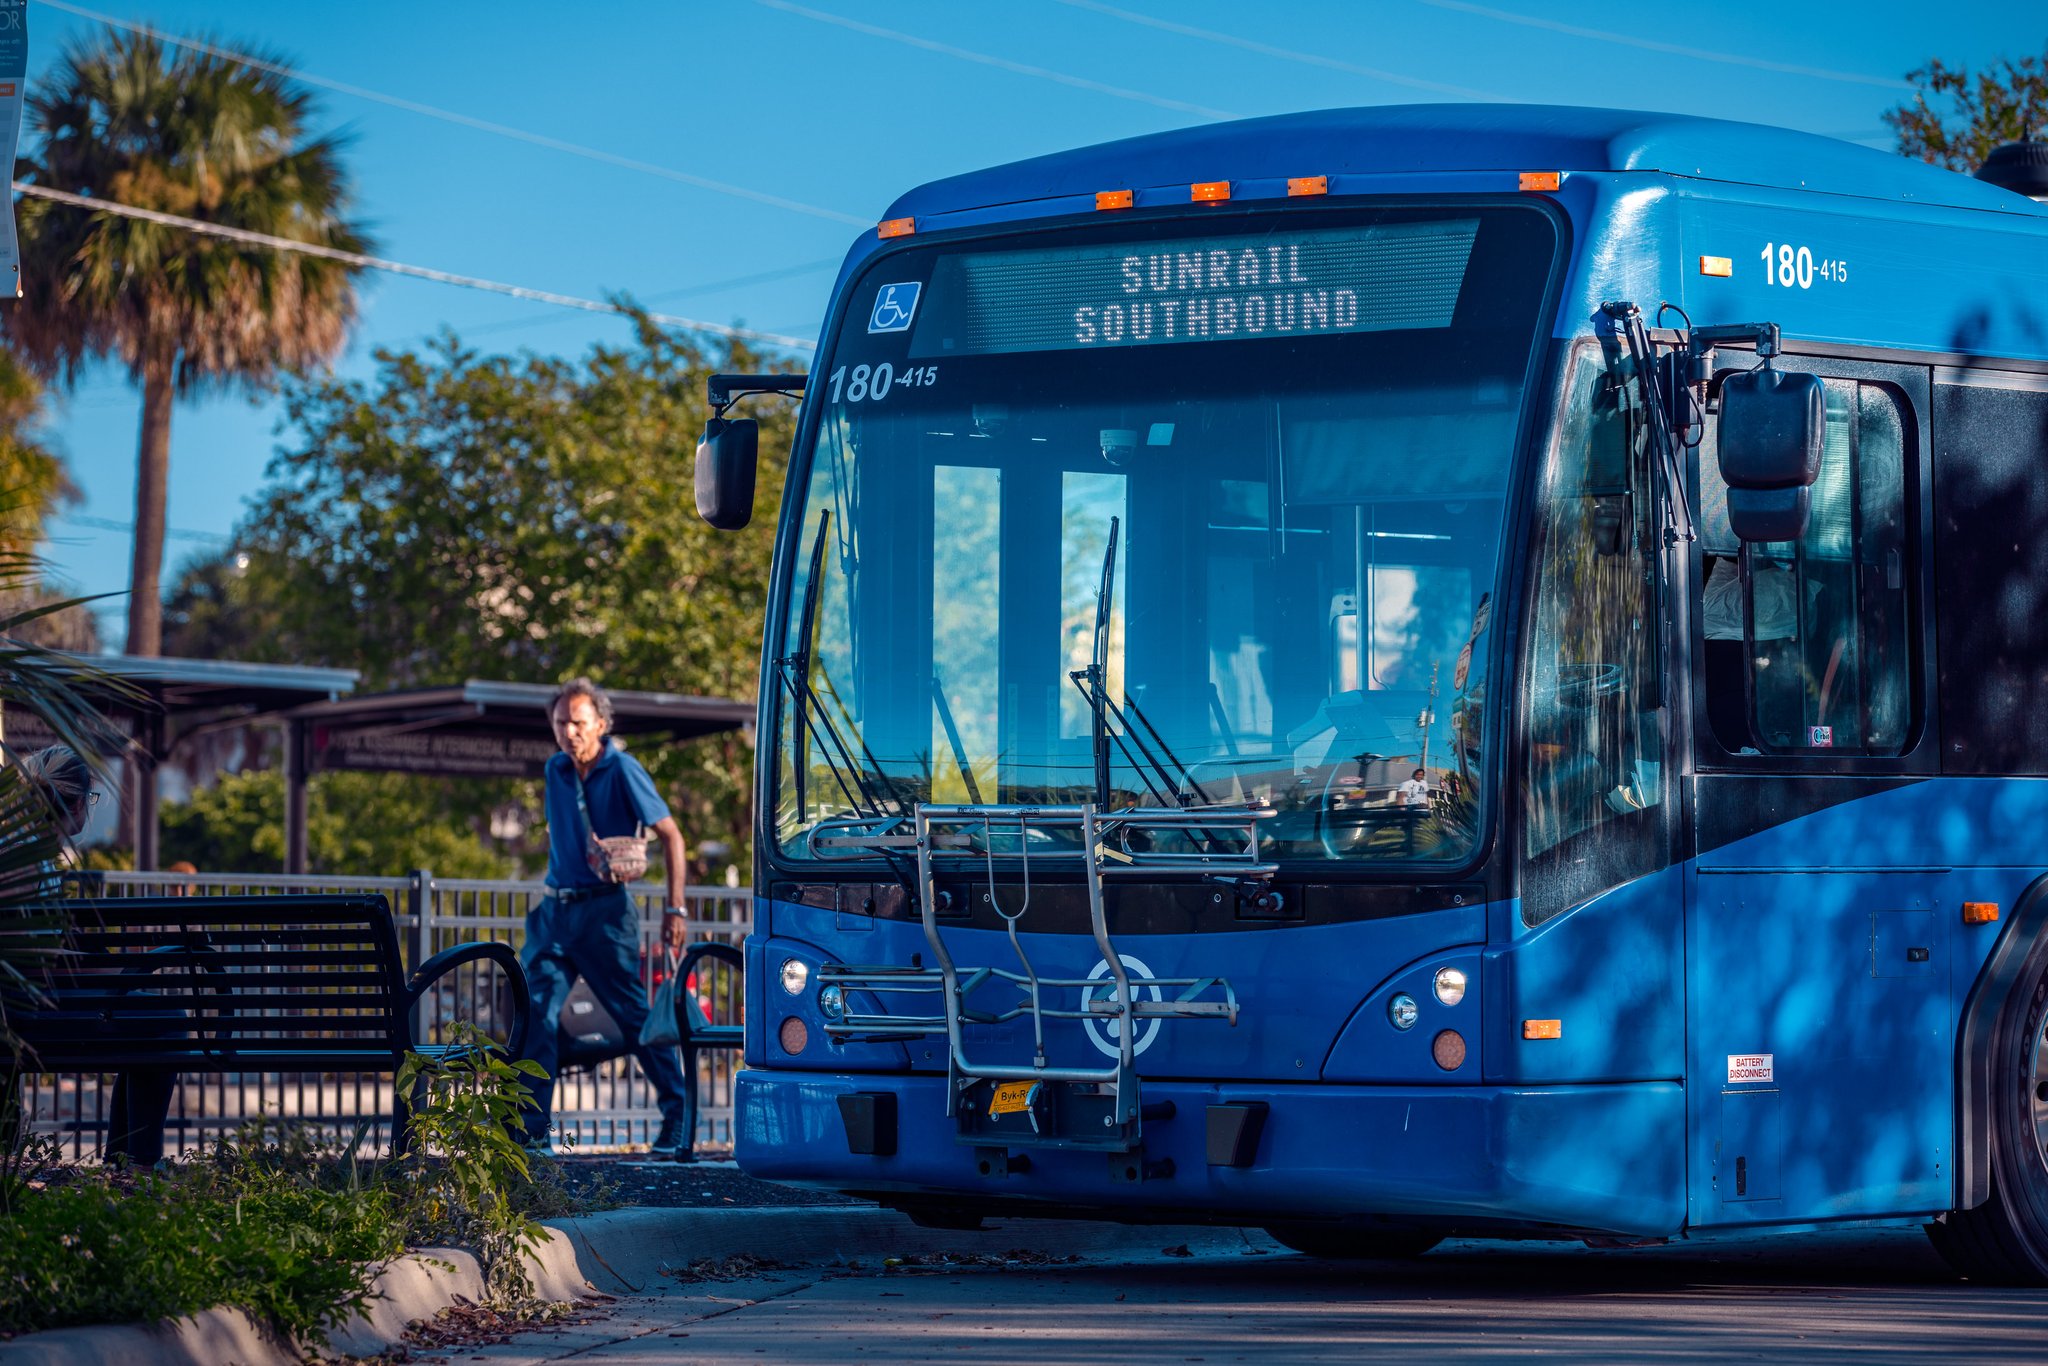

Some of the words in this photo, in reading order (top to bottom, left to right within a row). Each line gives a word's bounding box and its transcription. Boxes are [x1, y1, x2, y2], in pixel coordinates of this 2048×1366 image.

[1122, 245, 1309, 293] SUNRAIL
[1074, 289, 1358, 343] SOUTHBOUND
[1729, 1068, 1772, 1079] DISCONNECT
[1736, 1057, 1765, 1068] BATTERY
